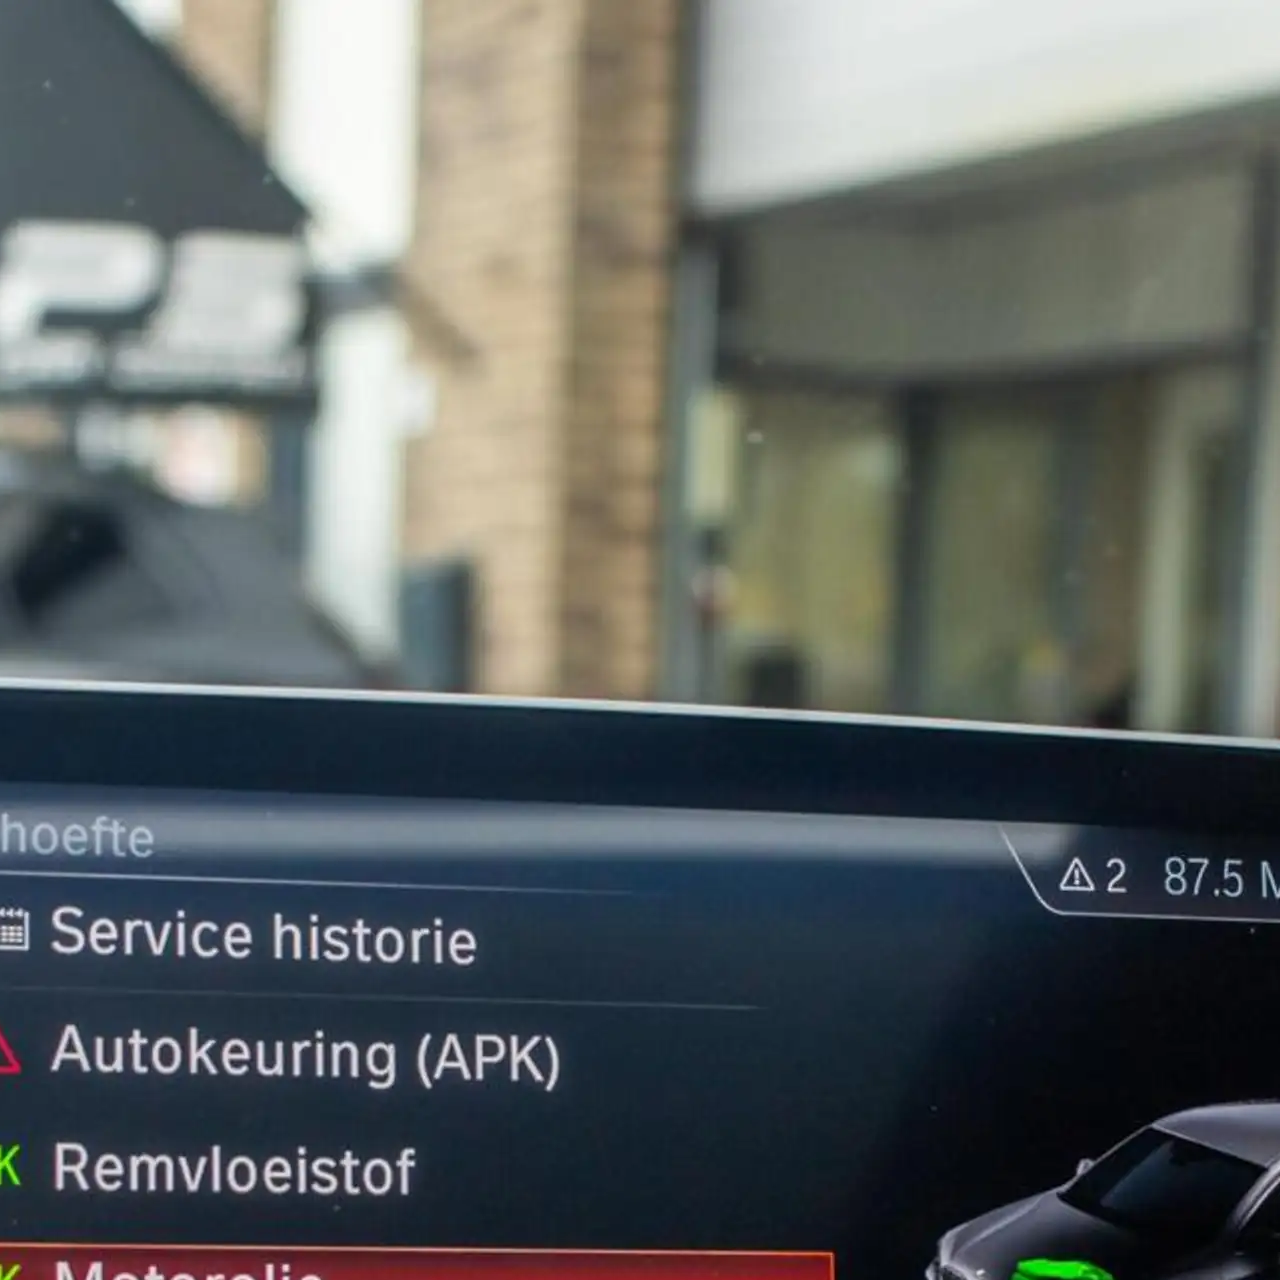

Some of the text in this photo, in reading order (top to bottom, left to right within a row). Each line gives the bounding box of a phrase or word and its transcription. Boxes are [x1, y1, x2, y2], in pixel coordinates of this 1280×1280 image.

[1106, 857, 1127, 893] 2
[1164, 856, 1244, 898] 87.5
[51, 906, 477, 965] Service historie
[51, 1024, 560, 1092] Autokeuring (APK)
[55, 1142, 416, 1195] Remvloeistof
